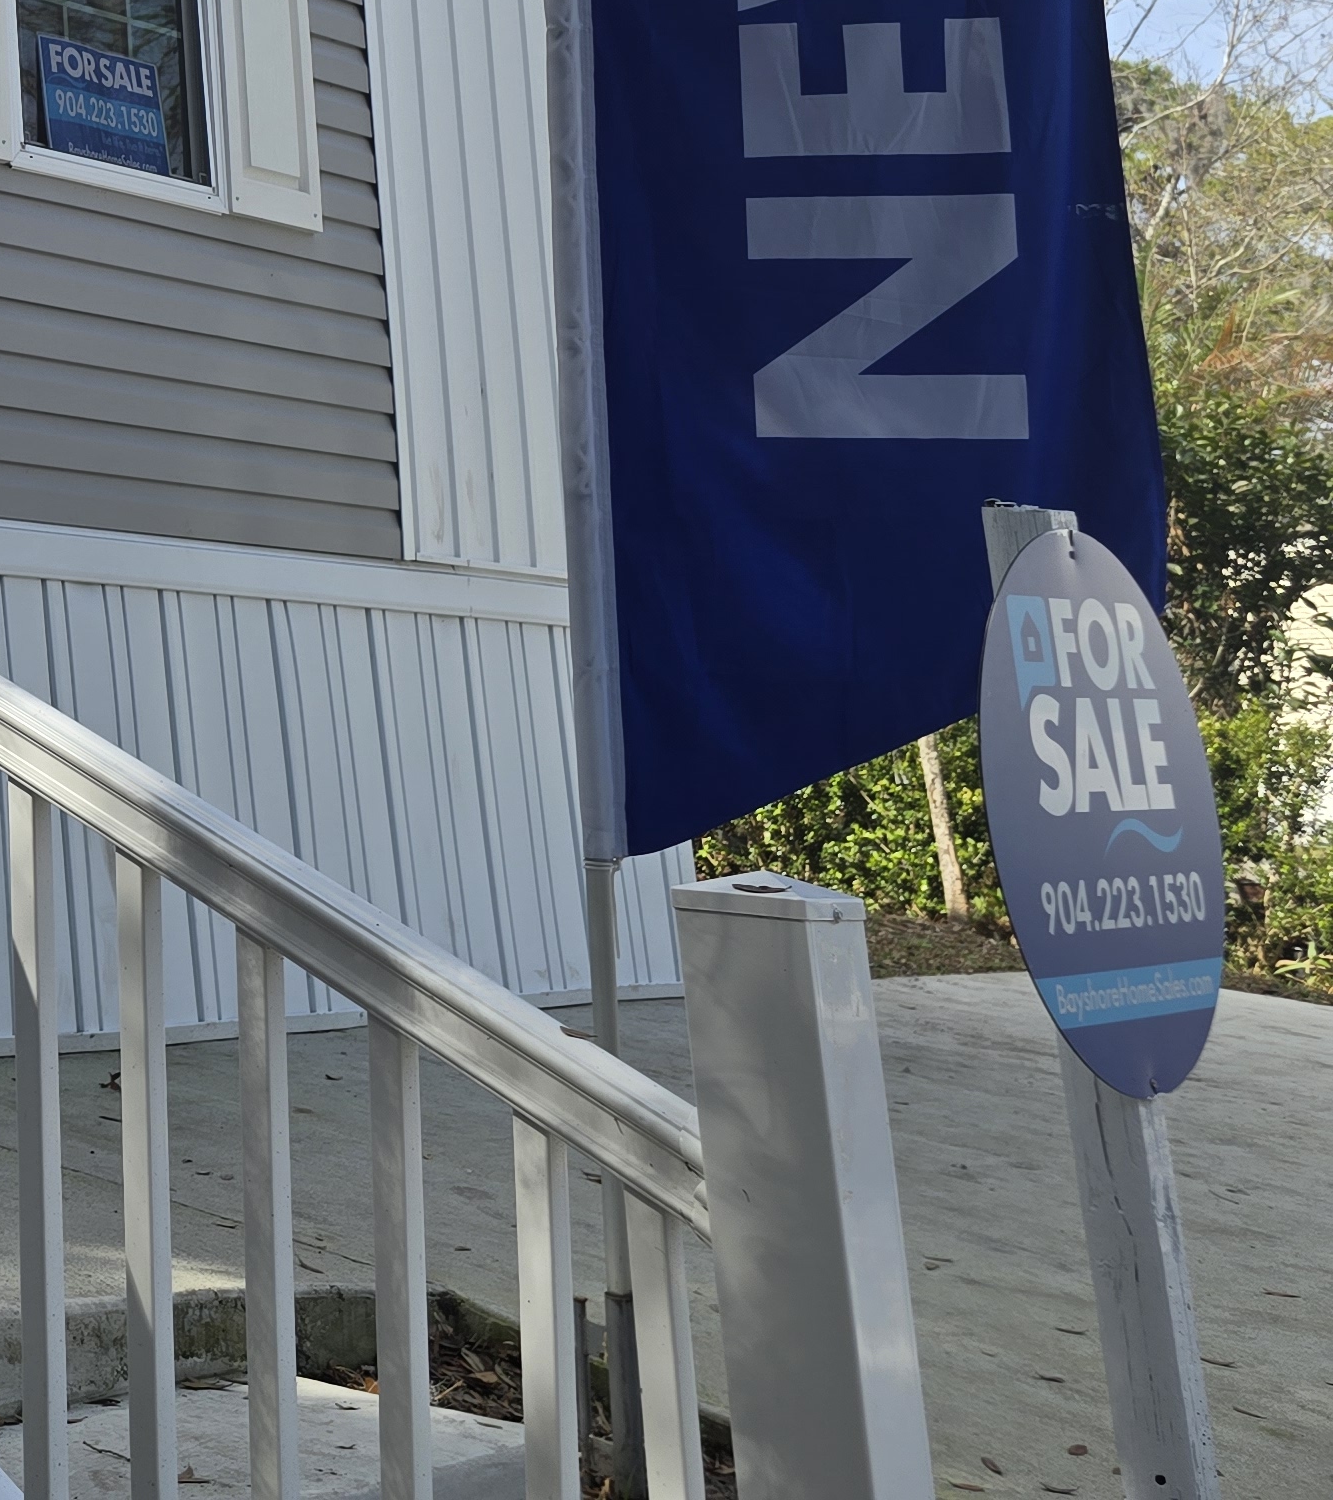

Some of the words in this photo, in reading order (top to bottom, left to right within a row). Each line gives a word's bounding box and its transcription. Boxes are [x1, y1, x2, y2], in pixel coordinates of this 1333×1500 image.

[48, 43, 99, 84] FOR
[99, 57, 154, 98] SALE
[55, 88, 158, 137] 904.223.1530
[1048, 597, 1156, 691] FOR
[1029, 693, 1177, 817] SALE
[1040, 871, 1206, 936] 904.223.1530
[1055, 968, 1214, 1023] BayshoreHomeSales.com
